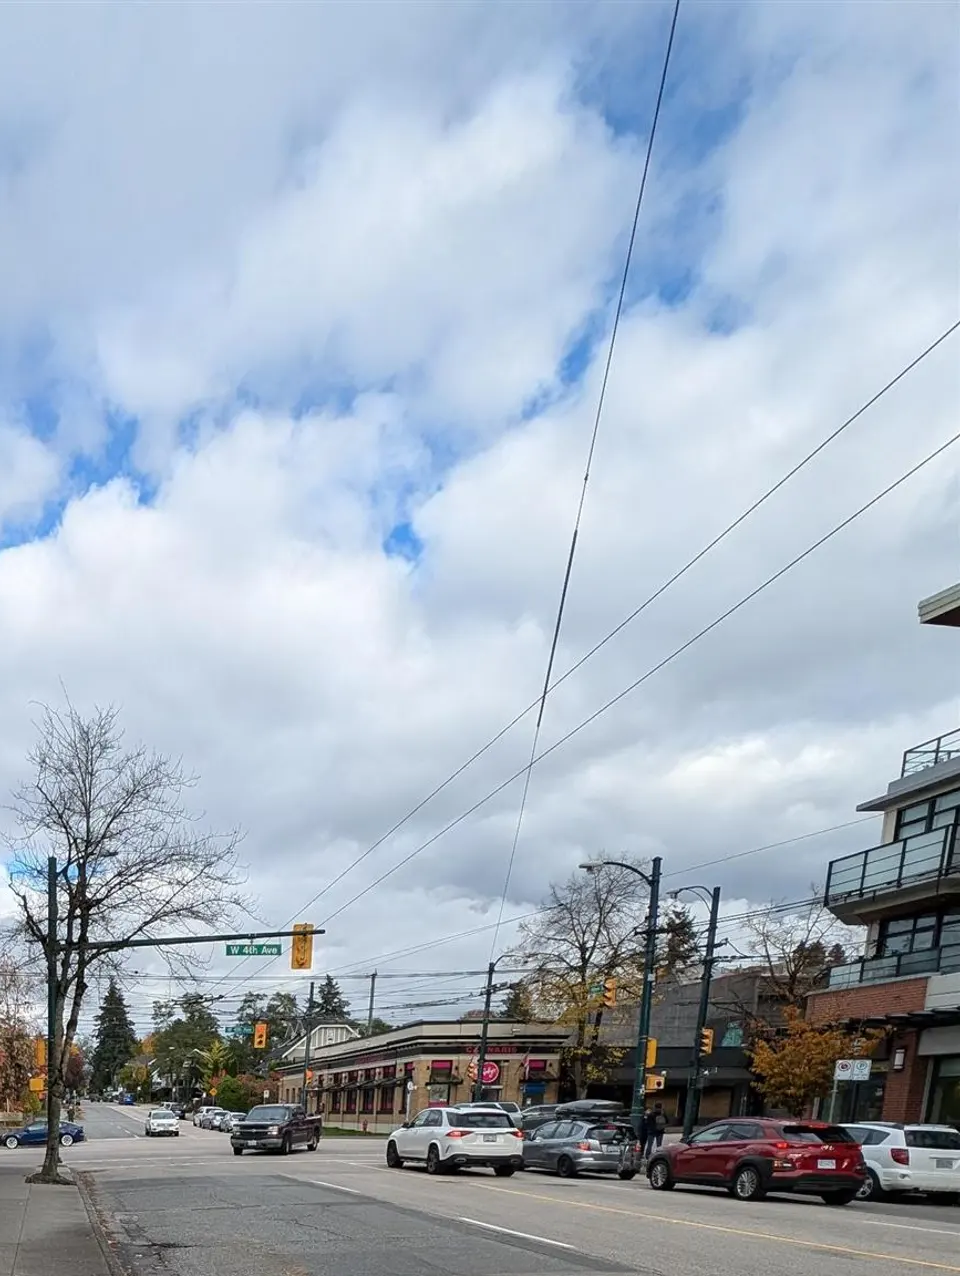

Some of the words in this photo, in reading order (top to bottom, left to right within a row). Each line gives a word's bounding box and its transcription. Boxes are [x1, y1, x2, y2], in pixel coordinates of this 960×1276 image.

[230, 946, 239, 954] W
[242, 946, 258, 954] 4th
[261, 946, 278, 954] Ave
[466, 1046, 517, 1054] CANABIS
